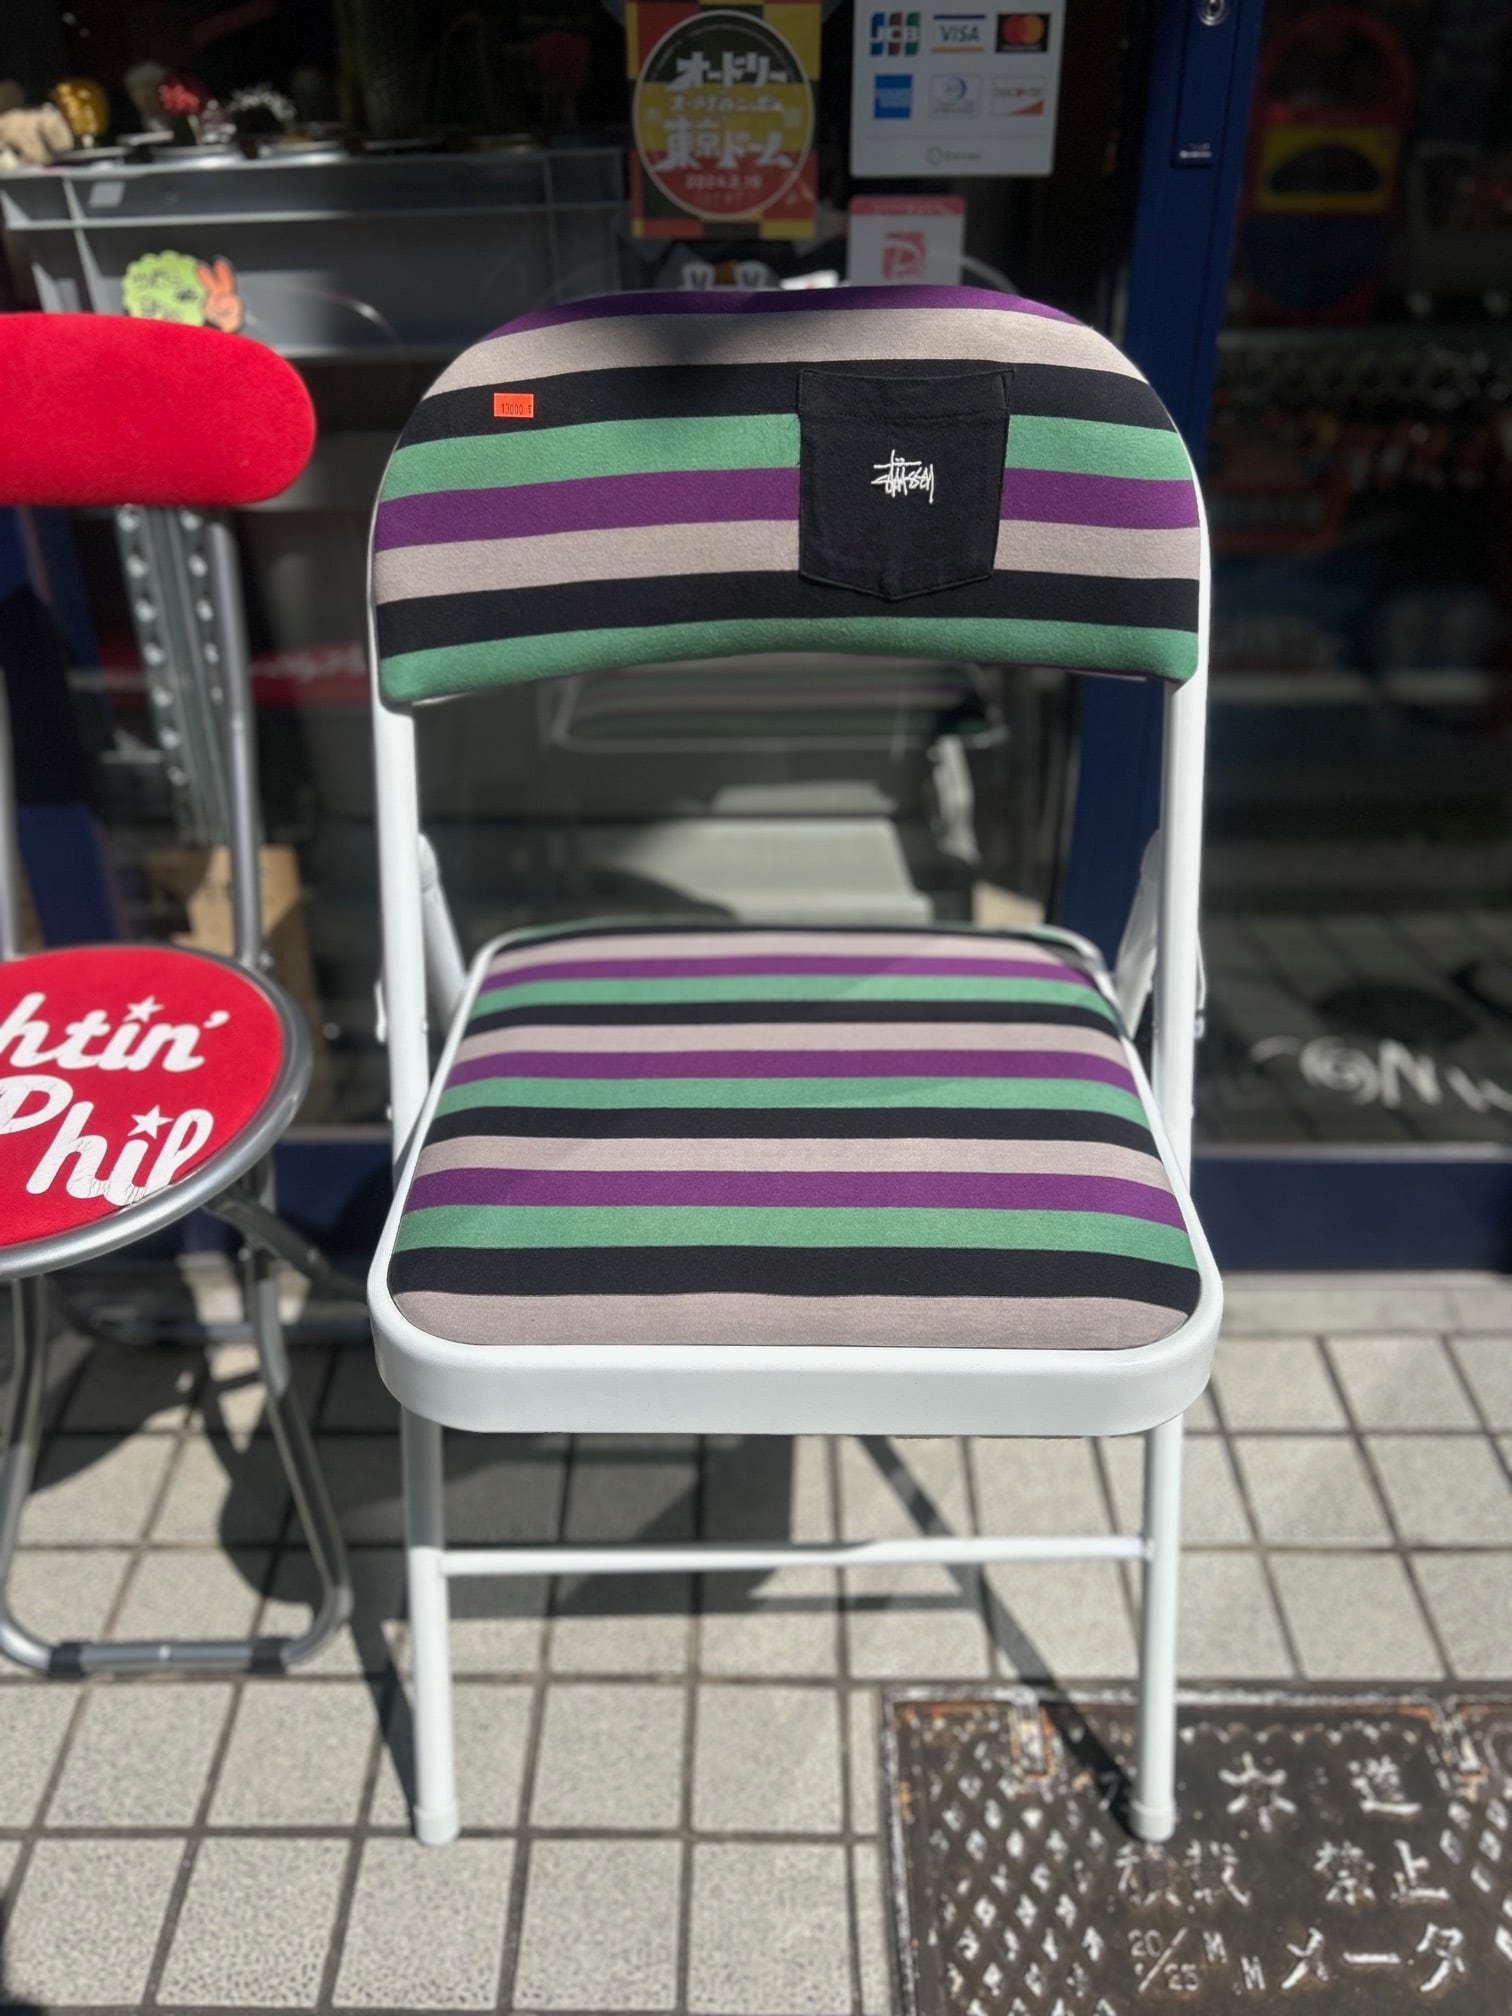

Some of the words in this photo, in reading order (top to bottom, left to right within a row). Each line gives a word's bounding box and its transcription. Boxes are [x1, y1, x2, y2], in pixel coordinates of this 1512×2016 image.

[939, 25, 980, 42] VISA
[664, 51, 788, 91] オードリー
[653, 115, 795, 170] 東京ドーム
[501, 403, 524, 416] 13000
[1218, 1752, 1422, 1830] 水道
